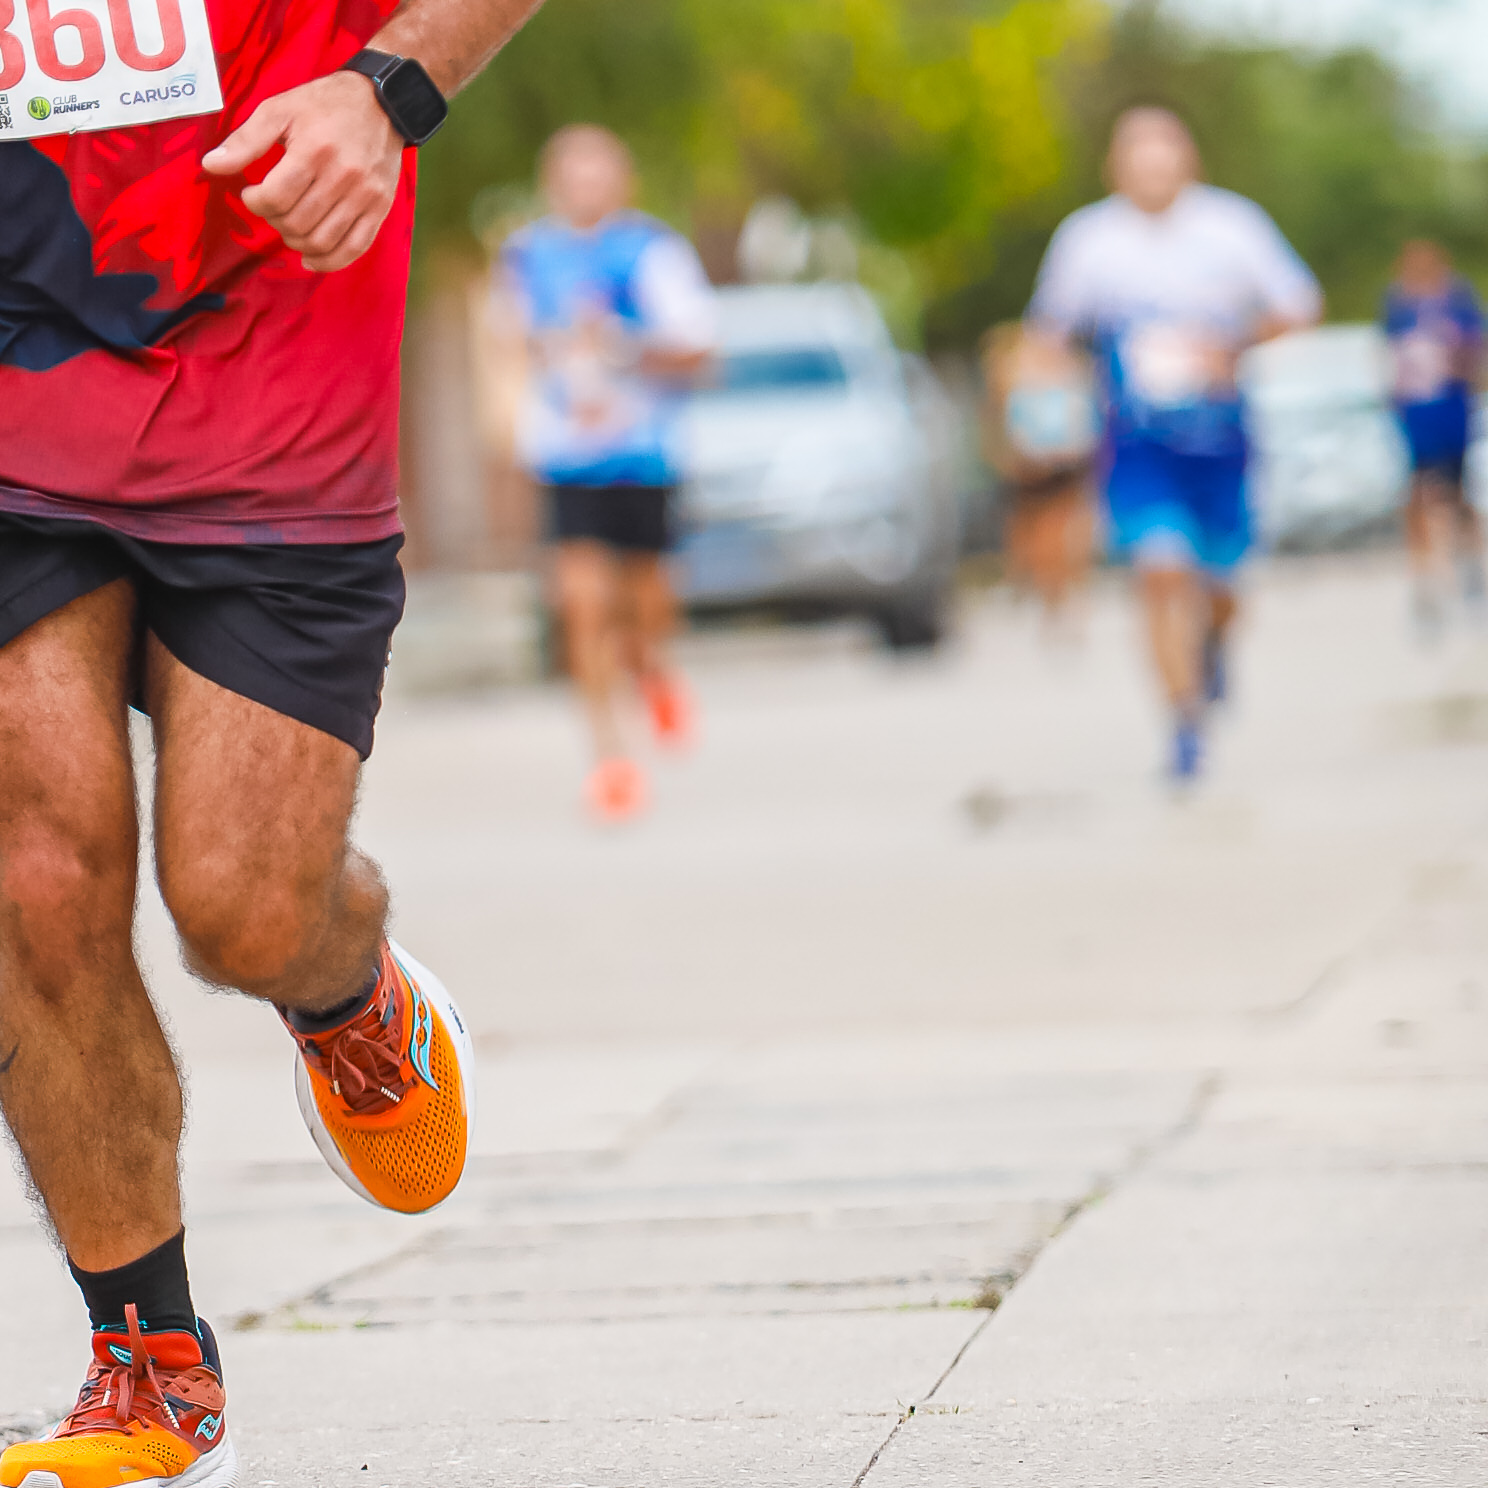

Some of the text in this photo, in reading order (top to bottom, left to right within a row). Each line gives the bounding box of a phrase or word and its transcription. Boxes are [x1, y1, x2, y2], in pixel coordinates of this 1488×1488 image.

[53, 95, 77, 105] CLUB
[119, 83, 196, 105] CARUSO
[53, 99, 101, 114] RUNNER'S
